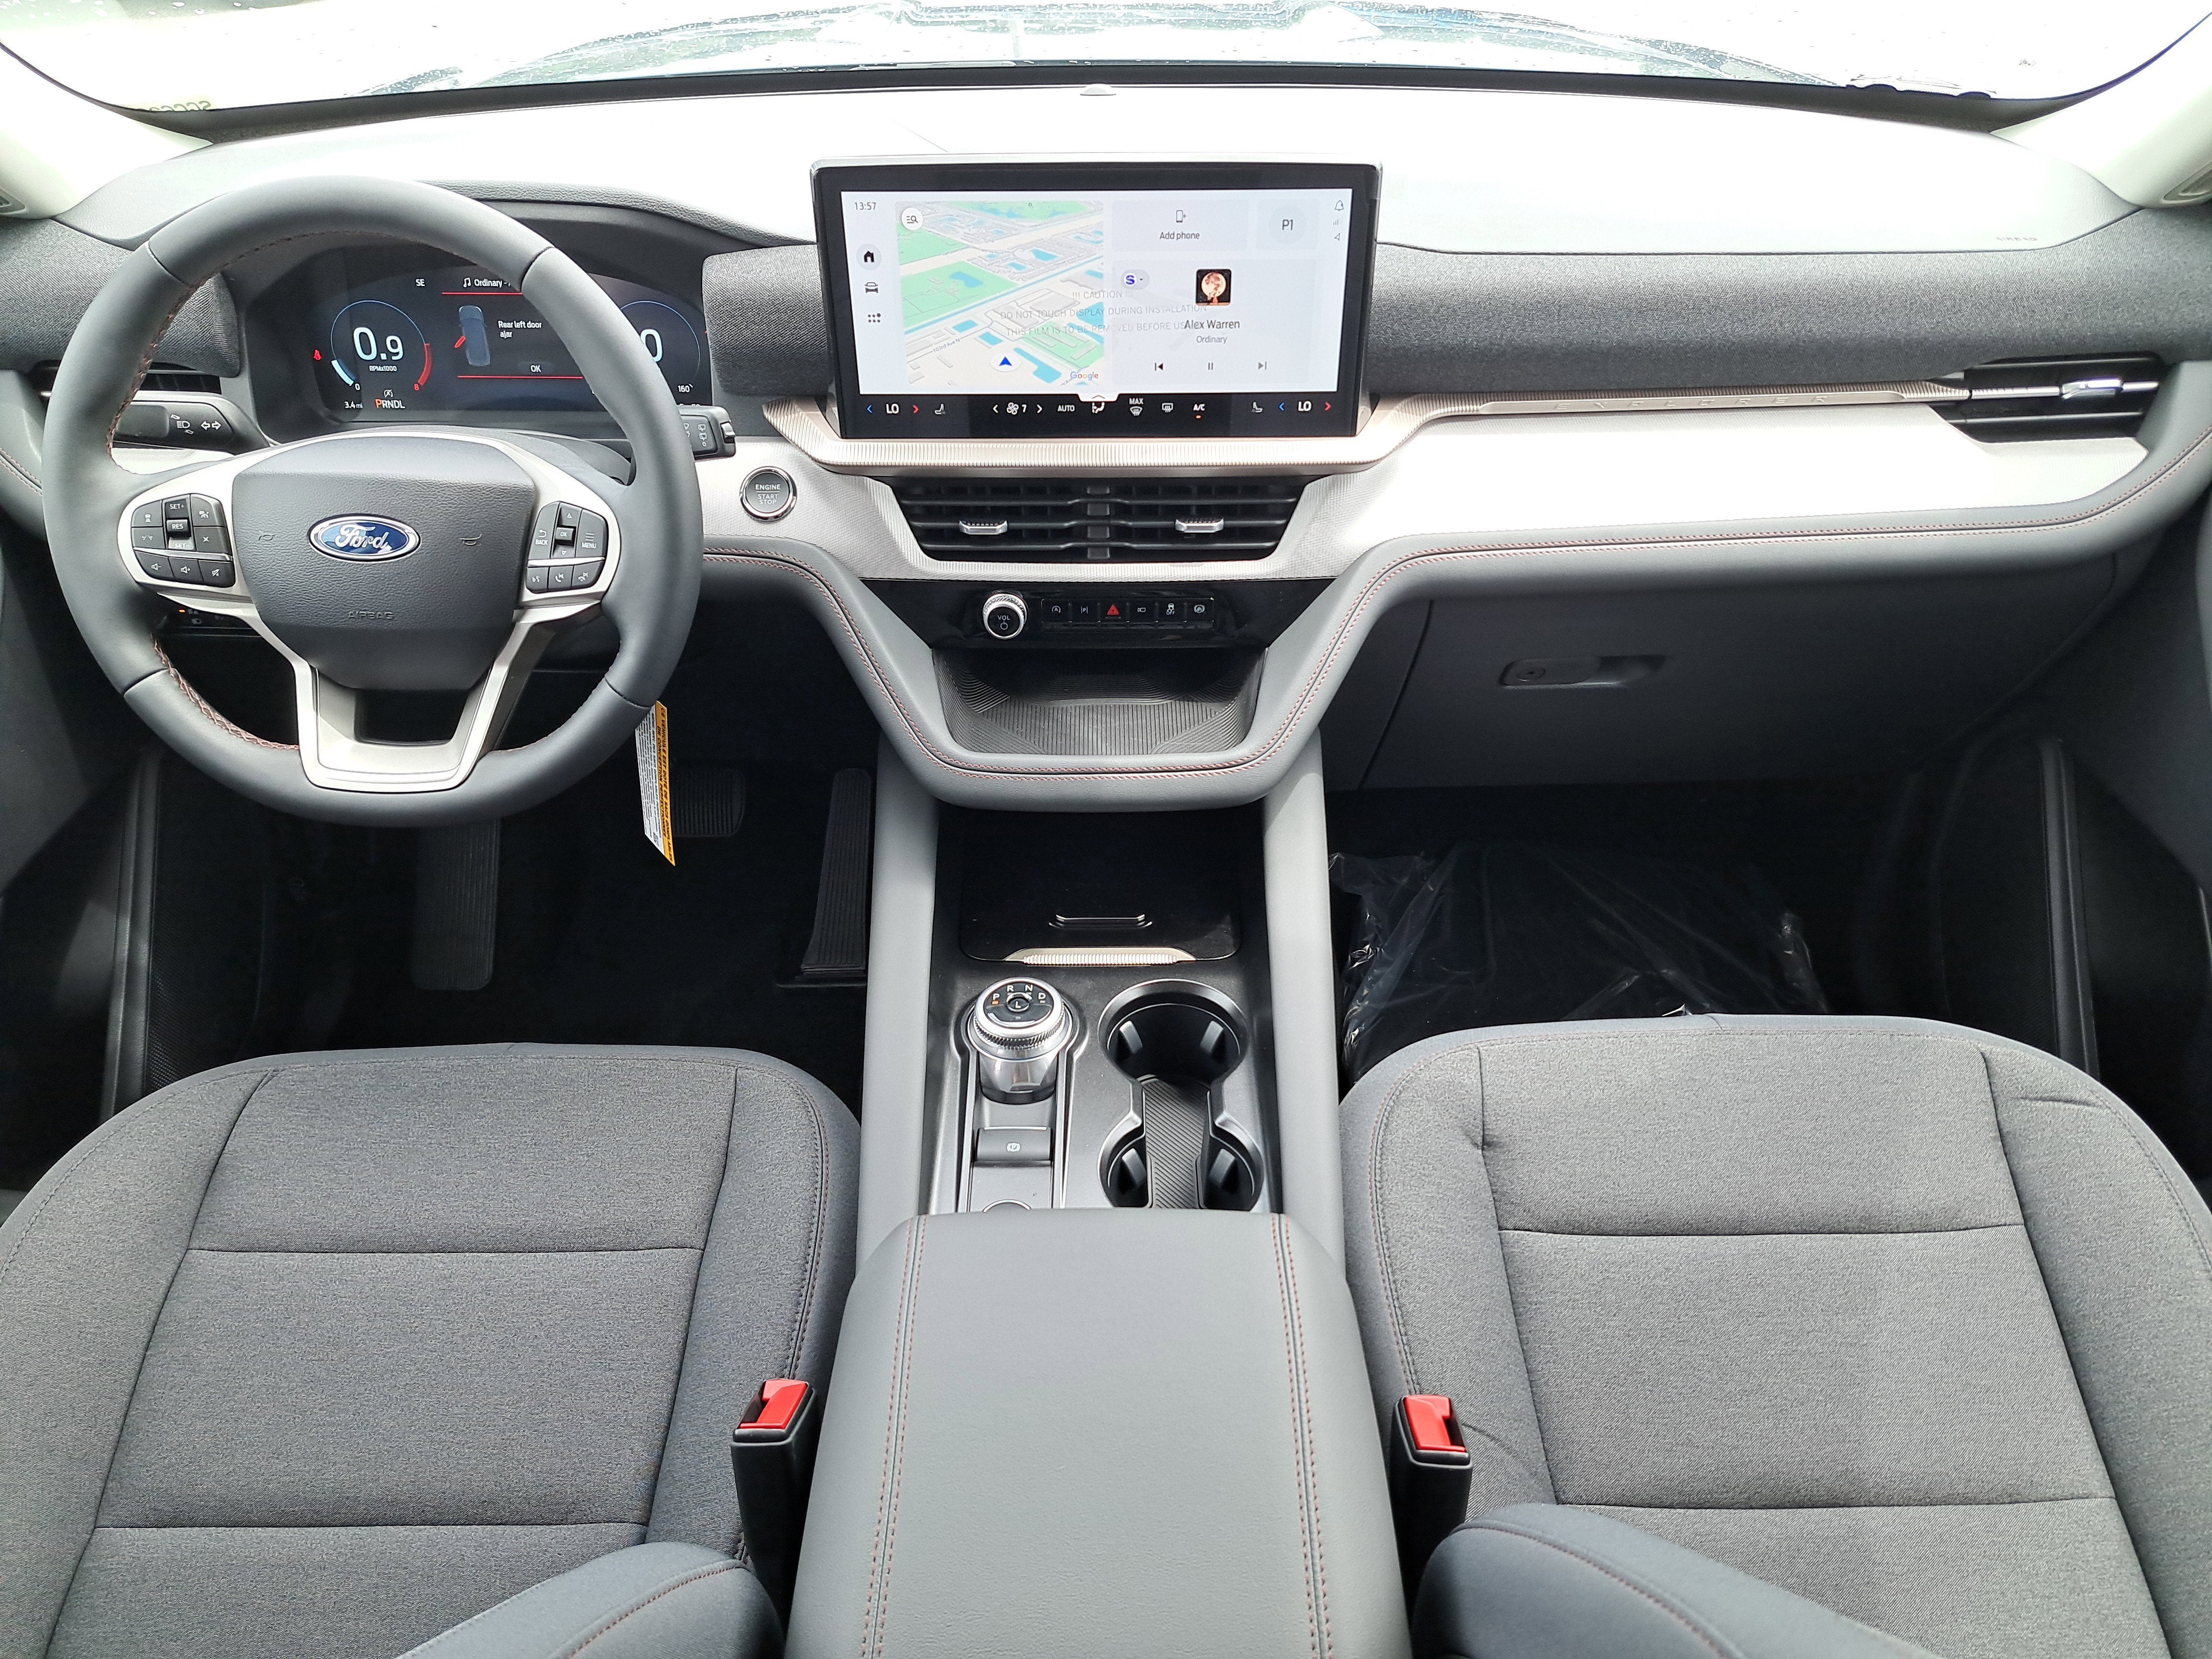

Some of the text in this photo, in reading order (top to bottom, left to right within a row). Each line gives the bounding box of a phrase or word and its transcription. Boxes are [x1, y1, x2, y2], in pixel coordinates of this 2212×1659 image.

[854, 201, 876, 210] 13:57
[1282, 219, 1294, 231] P1
[1160, 232, 1200, 241] Add phone
[416, 278, 425, 287] SE
[474, 278, 502, 288] Ordinary
[1084, 290, 1122, 299] CAUTION
[1070, 308, 1105, 317] DISPLAY
[1108, 307, 1142, 315] DURING
[498, 320, 542, 329] Rear left door
[1137, 322, 1171, 331] BEFORE
[1184, 320, 1240, 330] Alex Warren
[500, 330, 512, 339] ajar
[353, 327, 404, 361] 0.9
[1196, 335, 1228, 345] Ordinary
[531, 365, 542, 373] OK
[1070, 371, 1099, 381] Google
[344, 401, 355, 409] 3.4
[886, 404, 899, 414] LO
[1022, 405, 1027, 413] 7
[1058, 405, 1075, 413] AUTO
[1193, 403, 1205, 411] A/C
[1298, 401, 1312, 411] LO
[335, 524, 392, 553] Ford
